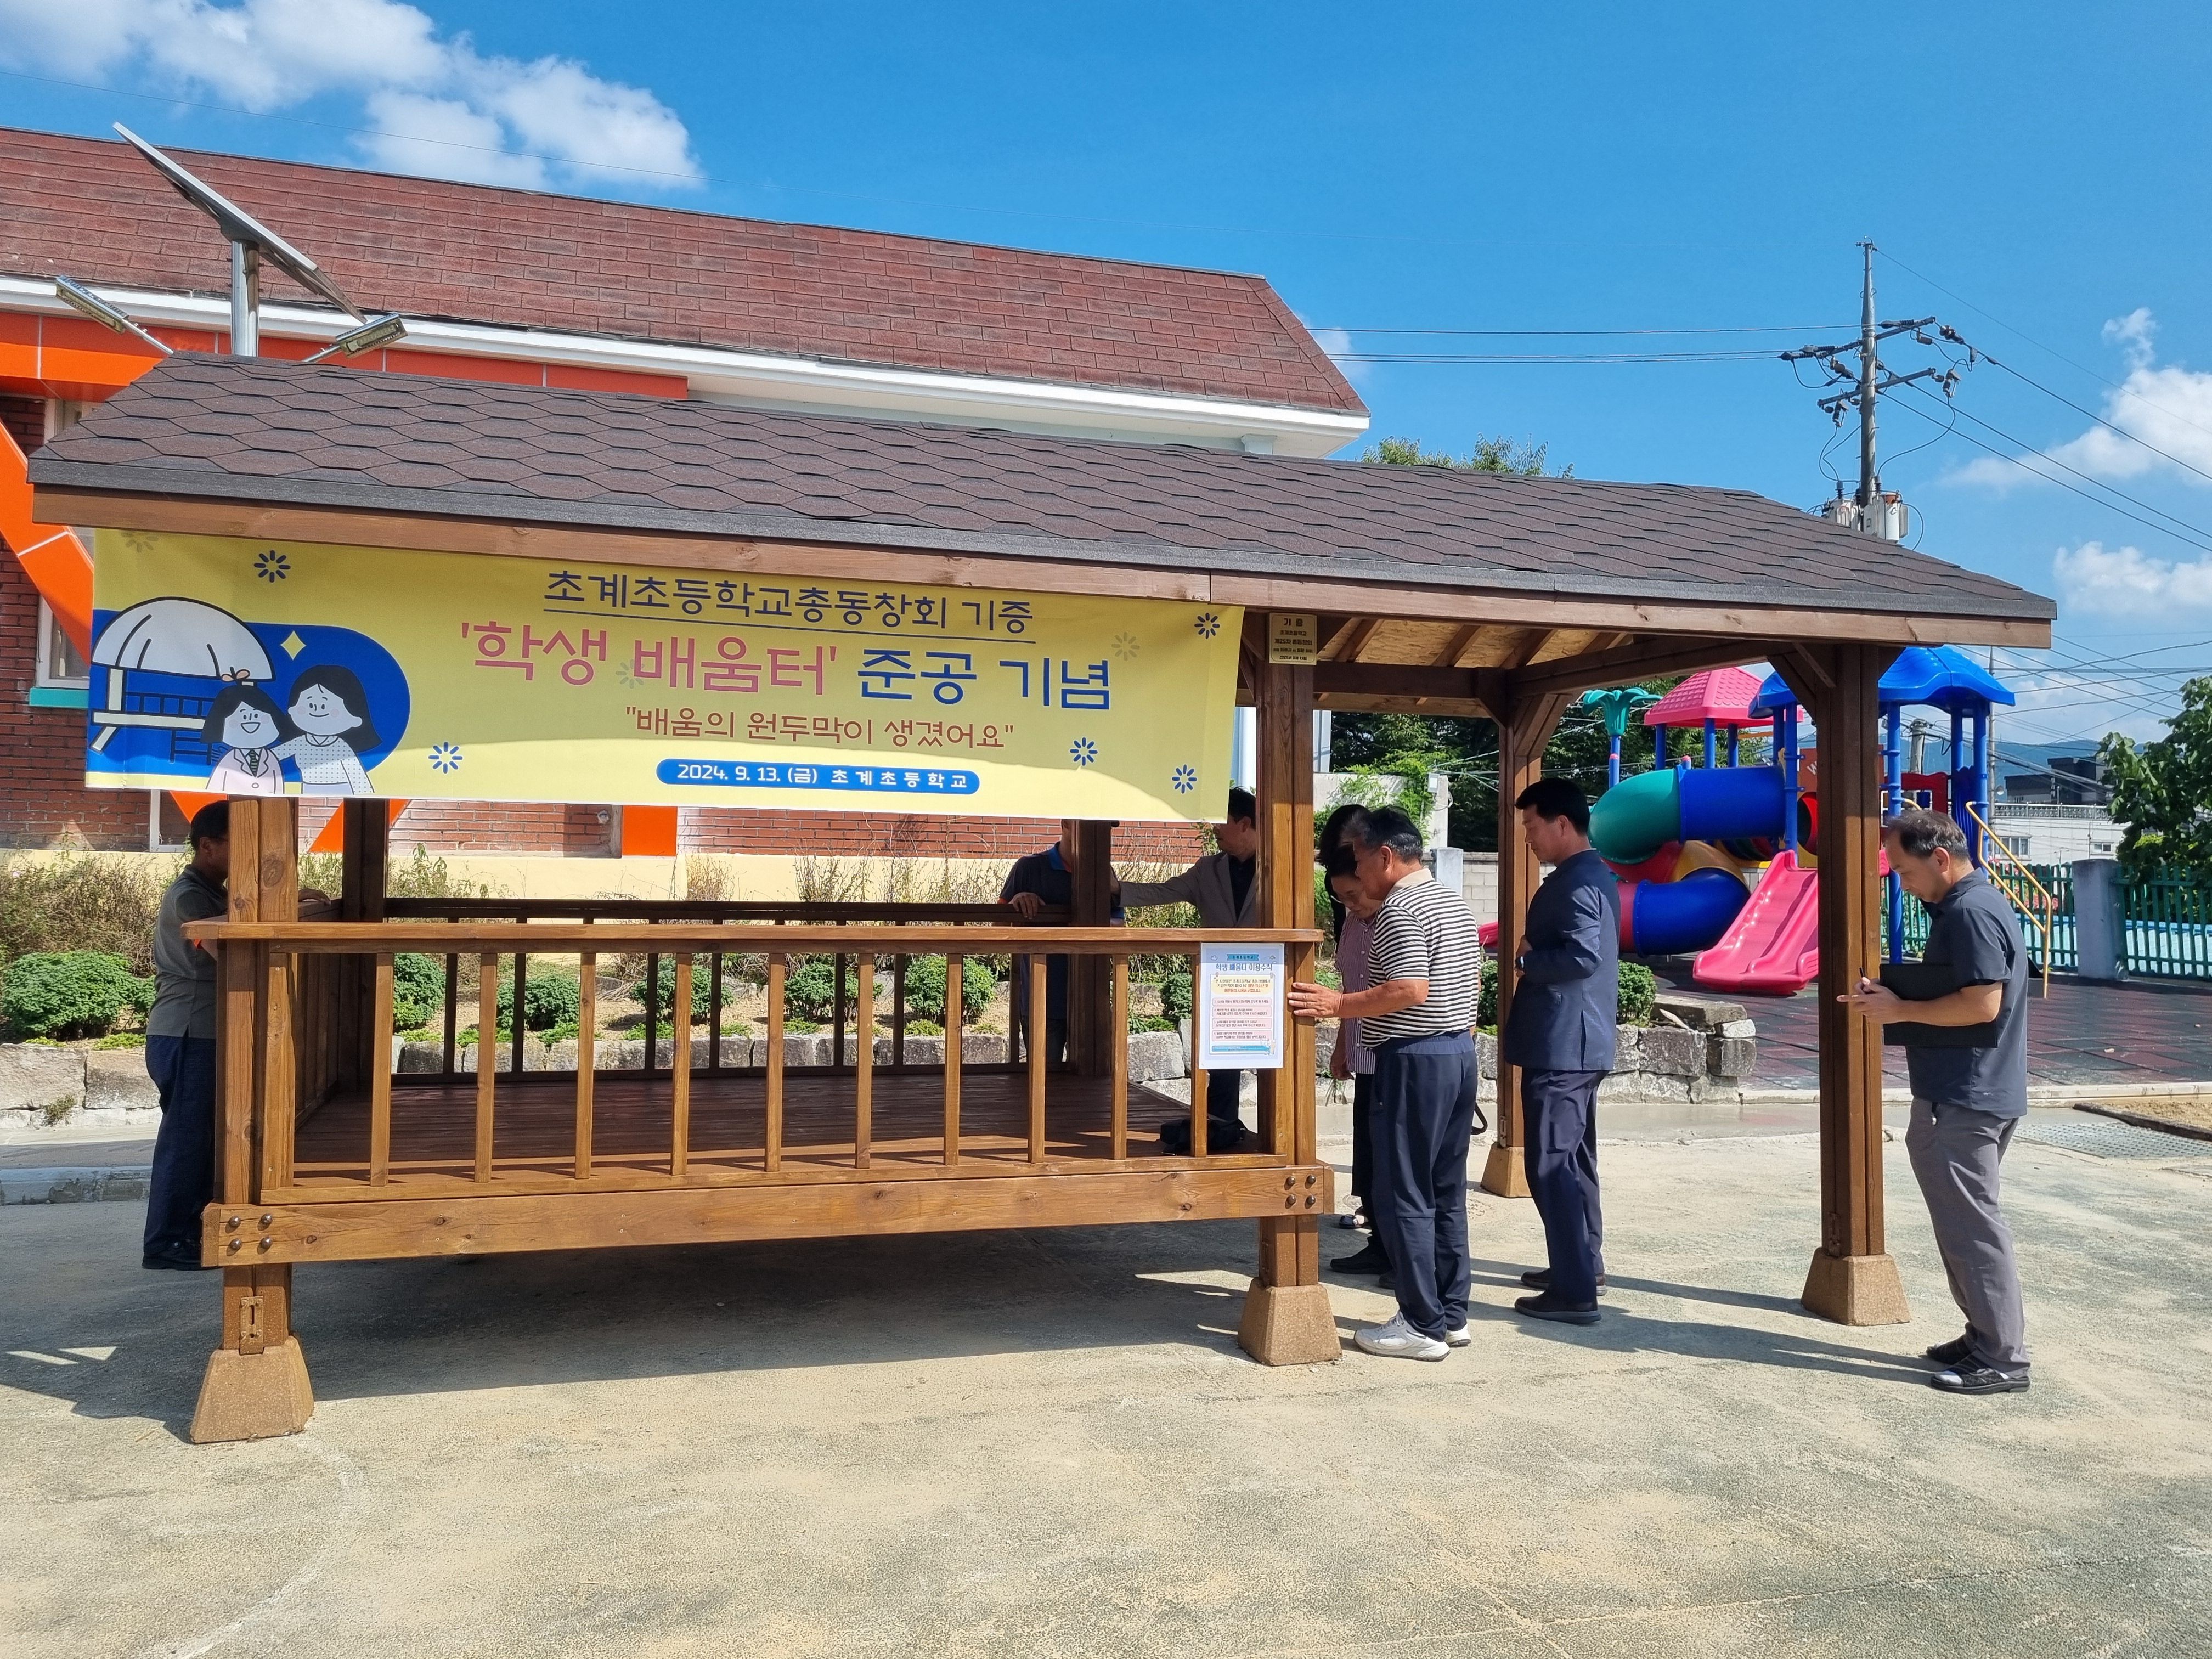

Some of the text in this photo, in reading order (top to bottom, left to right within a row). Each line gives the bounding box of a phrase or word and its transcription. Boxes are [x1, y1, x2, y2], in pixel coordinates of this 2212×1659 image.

[544, 568, 1033, 634] 초계초등학교총동창회 기증
[461, 619, 1111, 710] '학생 배움터' 준공 기념
[627, 706, 1014, 749] "배움의 원두막이 생겼어요"
[676, 764, 728, 780] 2024.
[735, 766, 751, 781] 9.
[757, 766, 781, 782] 13.
[788, 767, 817, 784] (금)
